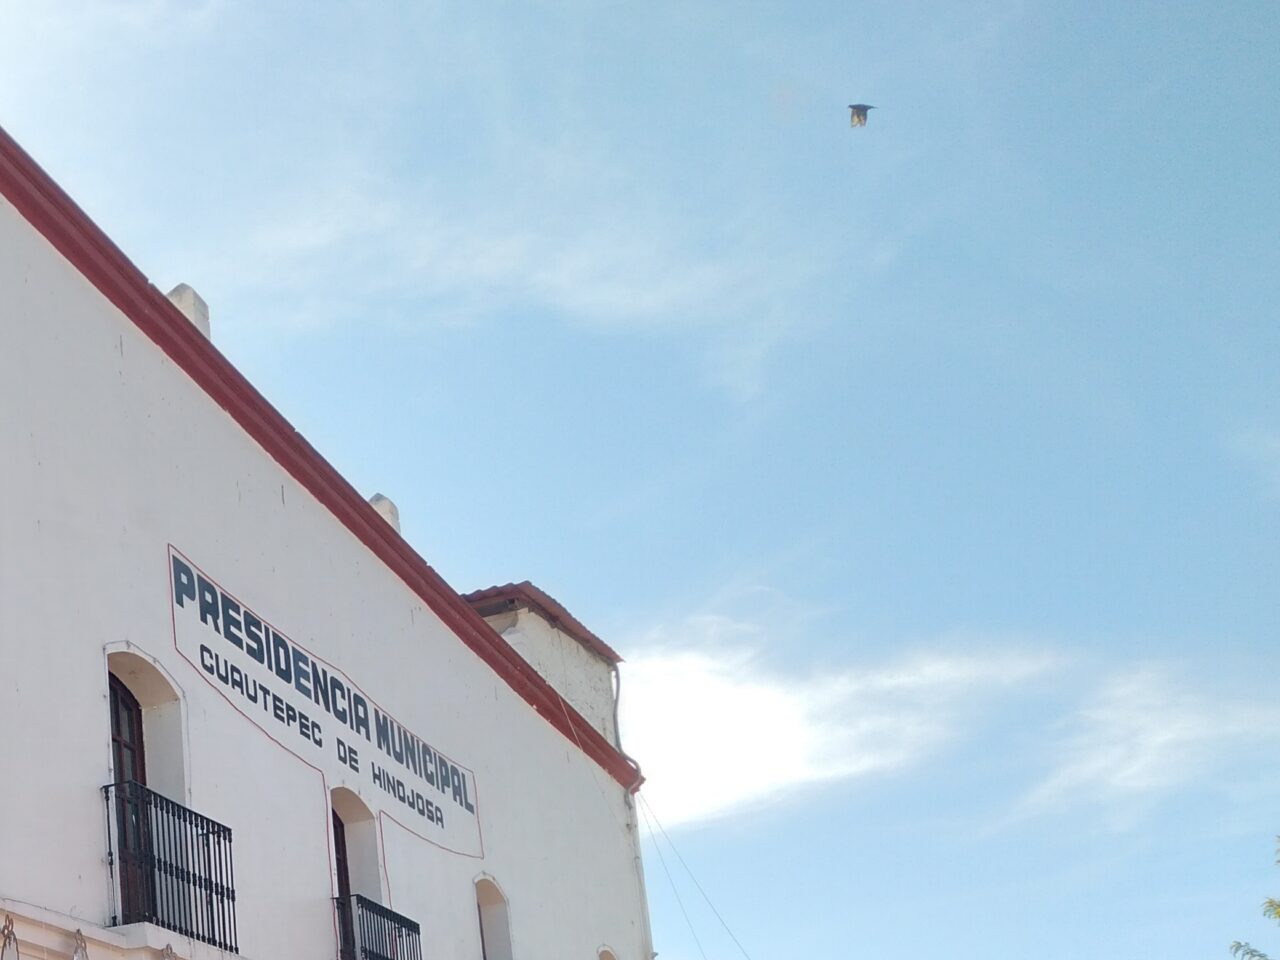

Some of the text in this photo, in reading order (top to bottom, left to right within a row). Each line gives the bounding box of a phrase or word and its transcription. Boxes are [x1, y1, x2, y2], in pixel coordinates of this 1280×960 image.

[171, 554, 476, 815] PRESIDENCIA MUNICIPAL
[199, 643, 445, 828] CUAUTEPEC DE HINOJOSA
